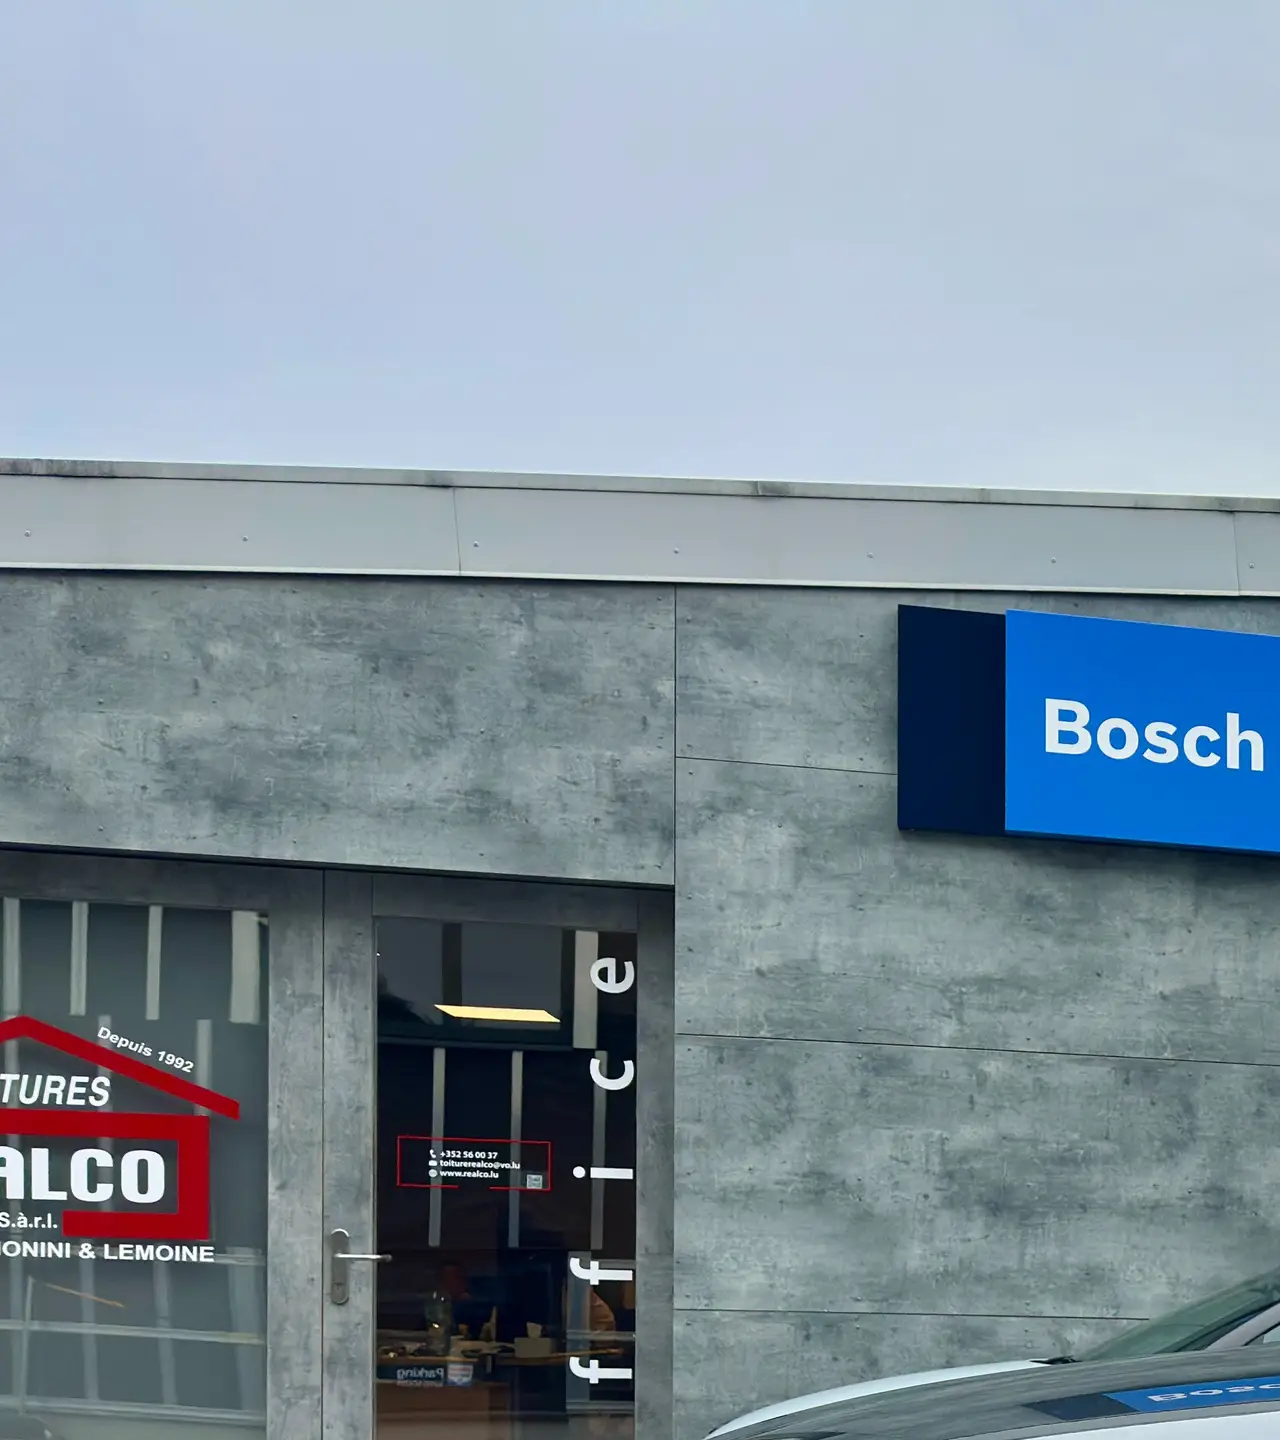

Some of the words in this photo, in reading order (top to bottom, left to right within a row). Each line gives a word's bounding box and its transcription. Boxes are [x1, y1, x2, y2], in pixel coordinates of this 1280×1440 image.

[1044, 697, 1265, 771] Bosch
[97, 1026, 153, 1057] Depuis
[157, 1050, 195, 1073] 1992
[439, 1150, 461, 1159] +352
[462, 1151, 474, 1159] 56
[475, 1151, 486, 1159] 00
[487, 1151, 498, 1160] 37
[439, 1170, 499, 1178] www.realco.lu
[0, 1241, 71, 1259] ONINI
[78, 1242, 96, 1260] &
[104, 1243, 215, 1263] LEMOINE
